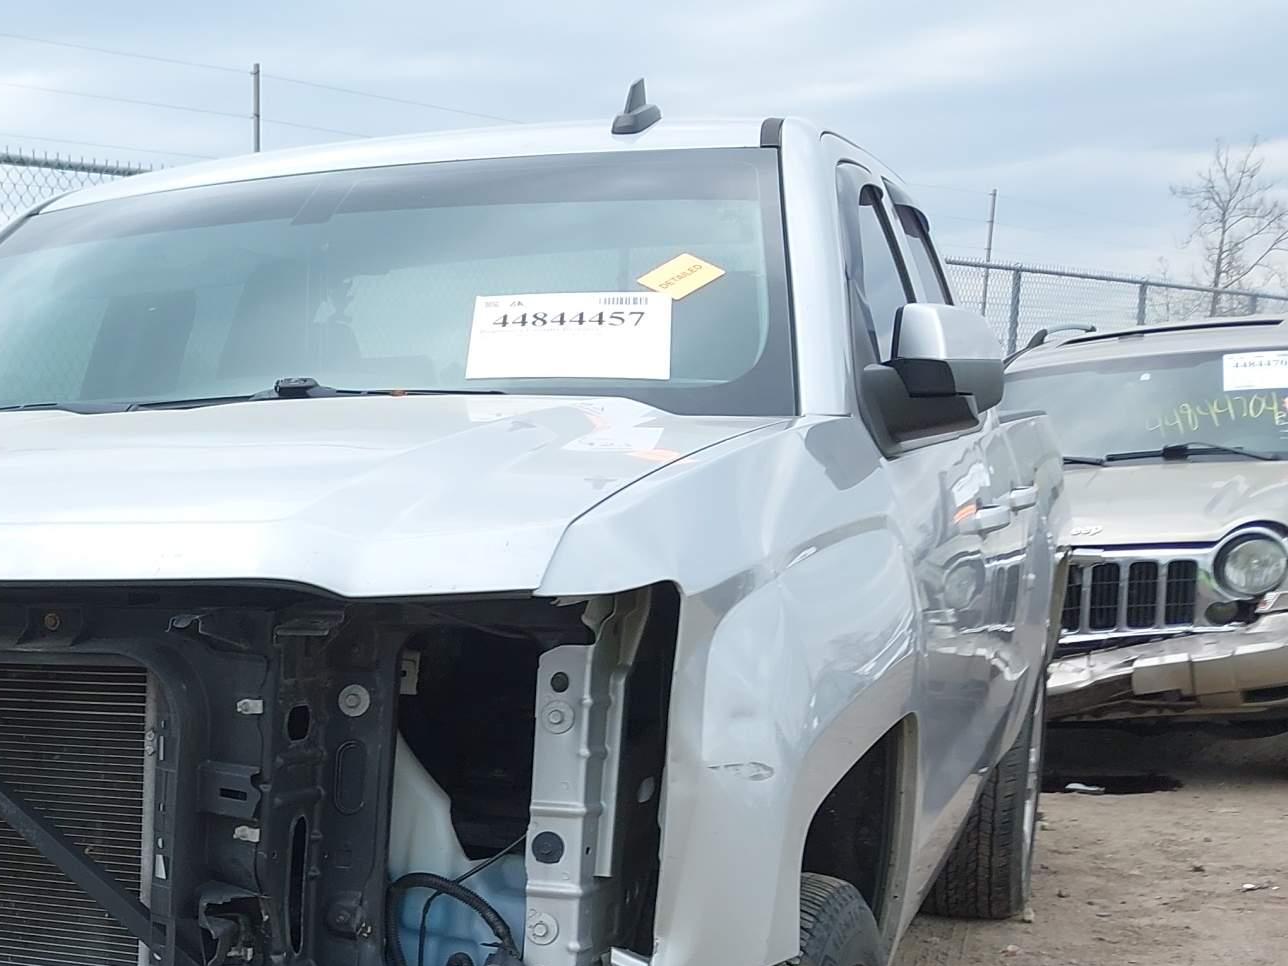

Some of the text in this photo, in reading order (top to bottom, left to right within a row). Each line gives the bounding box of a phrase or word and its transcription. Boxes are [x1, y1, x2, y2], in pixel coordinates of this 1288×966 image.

[658, 264, 703, 289] DETAILED
[492, 311, 645, 327] 44844457
[1145, 392, 1278, 438] 44844704
[1071, 525, 1104, 537] eep
